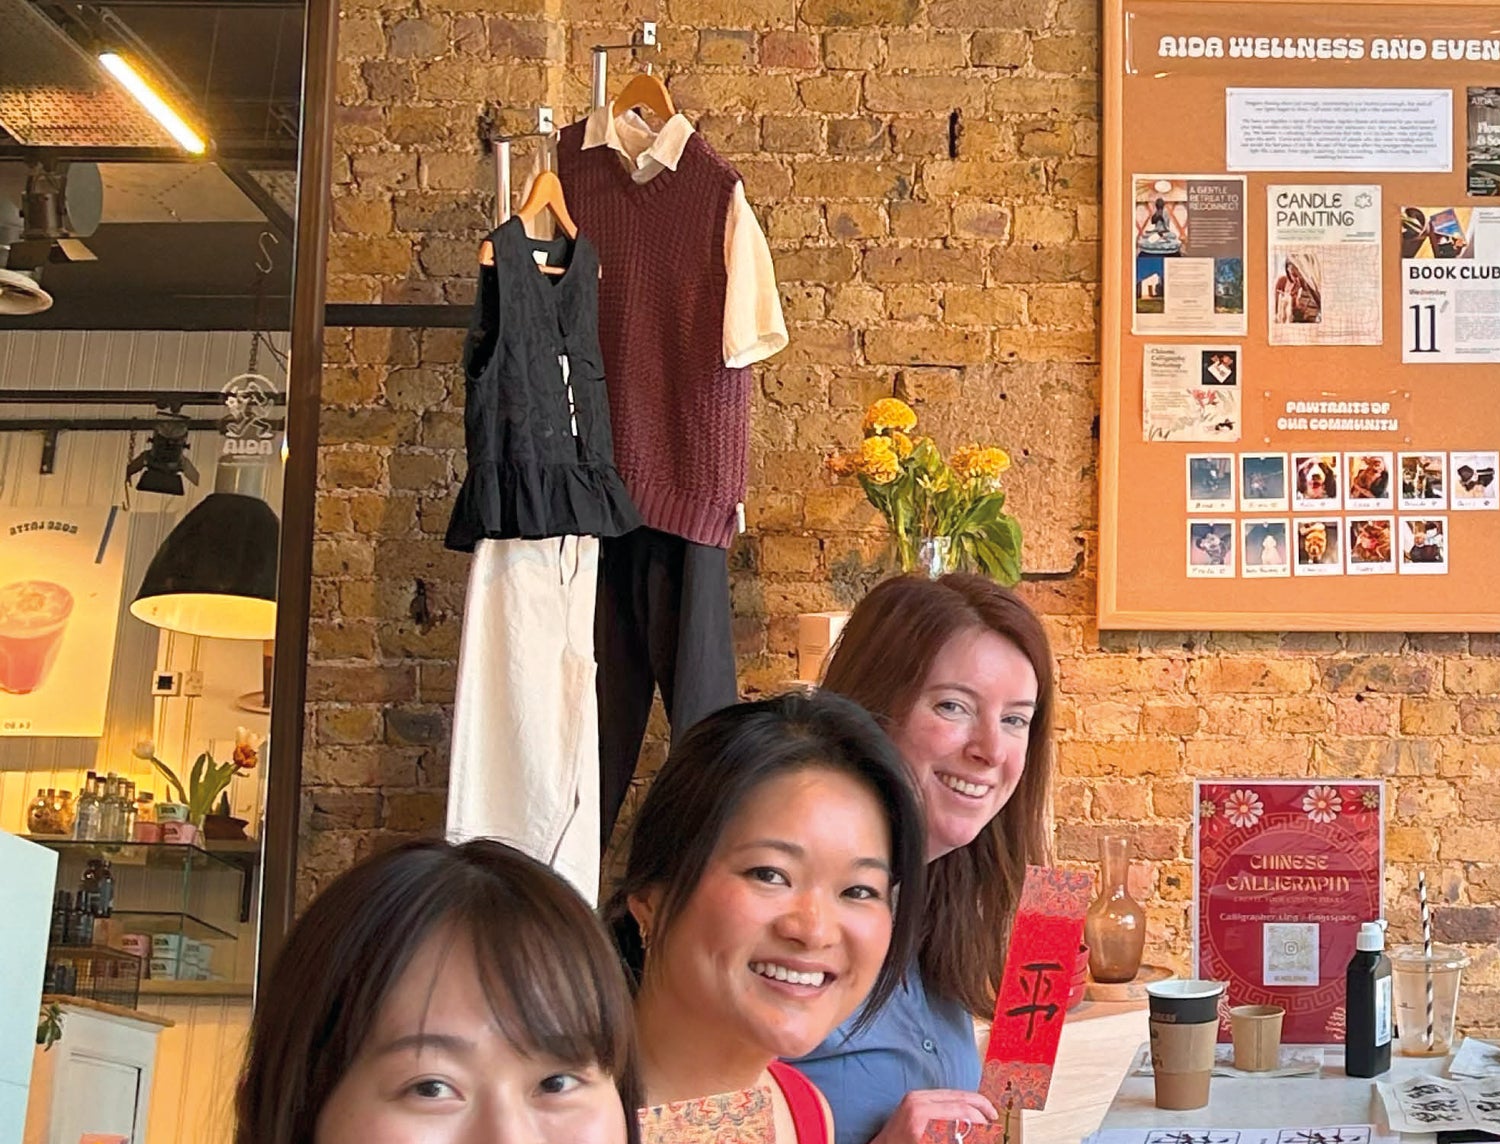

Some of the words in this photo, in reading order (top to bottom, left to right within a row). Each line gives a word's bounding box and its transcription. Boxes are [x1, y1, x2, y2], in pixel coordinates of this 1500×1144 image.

[1158, 36, 1224, 58] AIDA
[1228, 37, 1364, 59] WELLNESS
[1370, 38, 1427, 60] AND
[1276, 192, 1342, 209] CANDLE
[1277, 211, 1355, 227] PAINTING
[1409, 266, 1456, 279] BOOK
[1409, 304, 1441, 353] 11
[1286, 401, 1370, 414] PAWTRAITS
[1371, 402, 1390, 414] OF
[1277, 418, 1308, 430] OUR
[1309, 418, 1398, 431] COMMUNITY
[1250, 855, 1329, 870] CHINESE
[1226, 876, 1351, 891] CALLIGRAPHY
[1007, 963, 1061, 1041] 平
